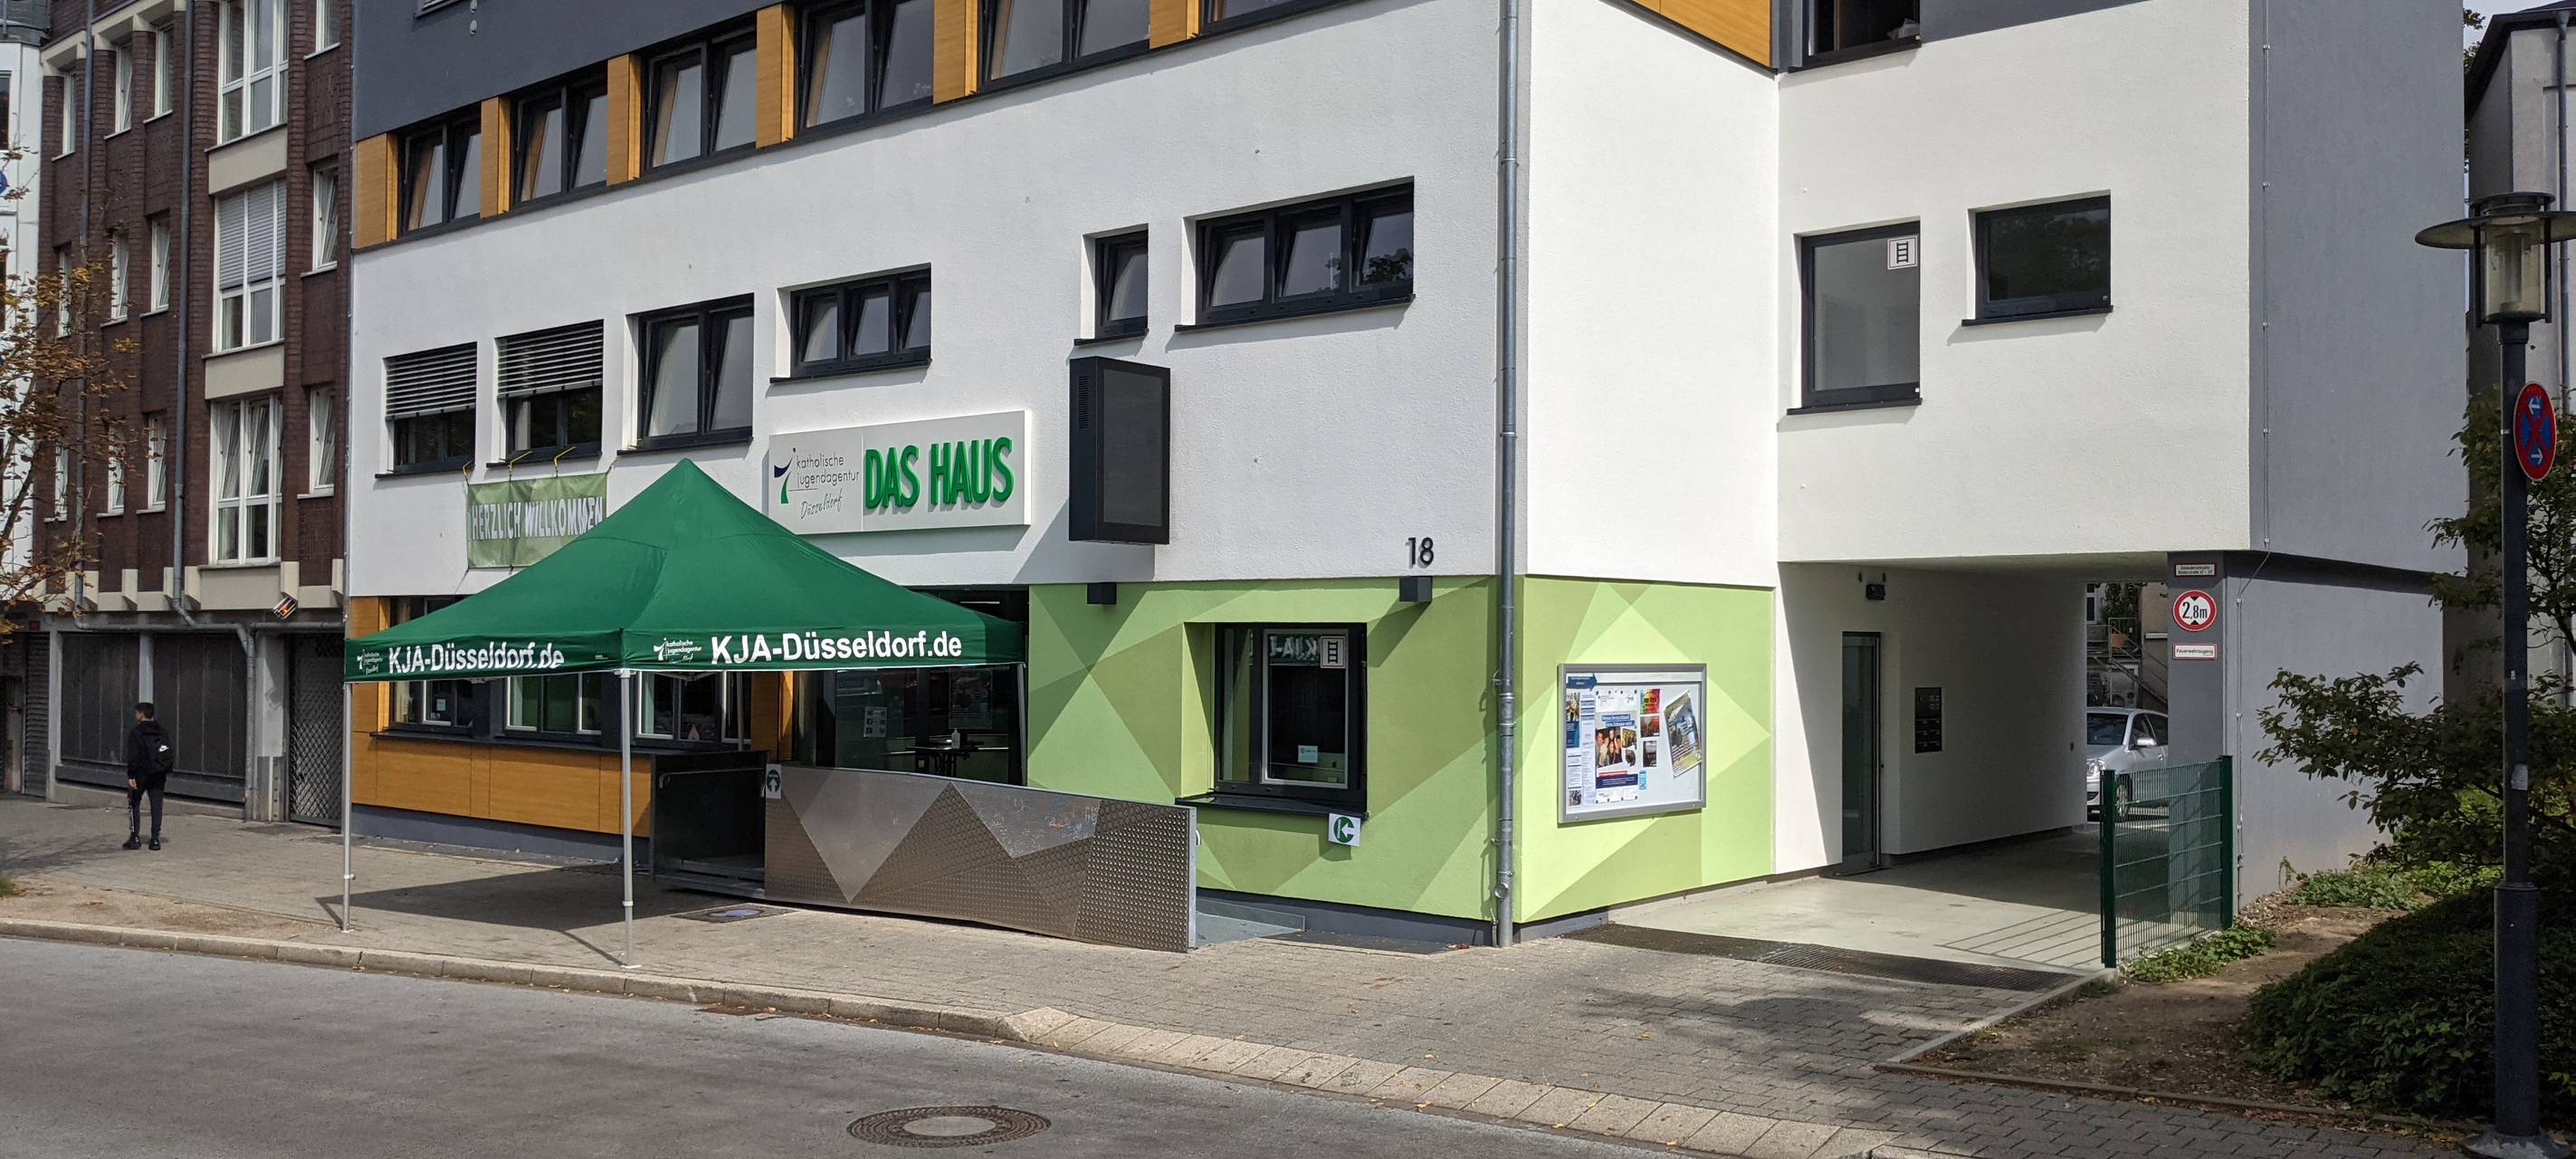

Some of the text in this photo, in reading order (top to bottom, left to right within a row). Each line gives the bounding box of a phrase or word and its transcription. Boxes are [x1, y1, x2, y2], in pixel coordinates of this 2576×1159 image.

[797, 453, 844, 469] katholische
[865, 436, 1015, 509] DAS HAUS
[797, 469, 860, 489] jugendagentur
[472, 496, 603, 540] HERZLICH WILLKOMMEN
[801, 488, 843, 520] Düsseldorf
[1407, 537, 1435, 565] 18
[388, 641, 565, 674] KJA-Düsseldorf.de
[711, 630, 962, 665] KJA-Düsseldorf.de
